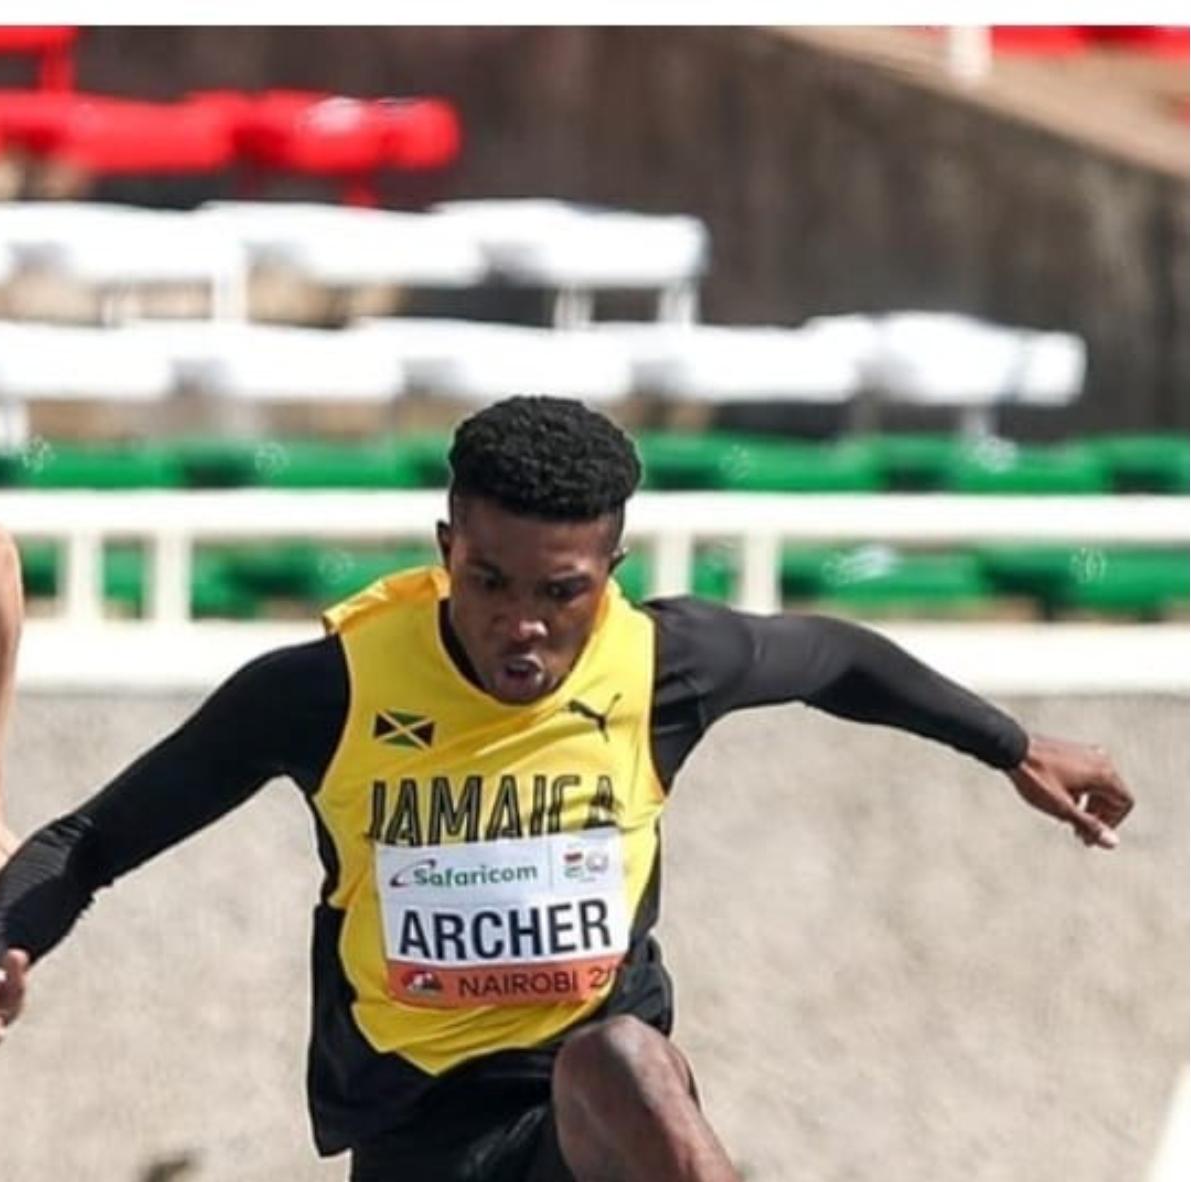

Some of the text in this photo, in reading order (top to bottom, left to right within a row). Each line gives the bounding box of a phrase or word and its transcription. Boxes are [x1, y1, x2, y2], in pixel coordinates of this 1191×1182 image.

[412, 864, 538, 888] Safaricom
[398, 899, 612, 961] ARCHER
[458, 969, 578, 998] NAIROBI
